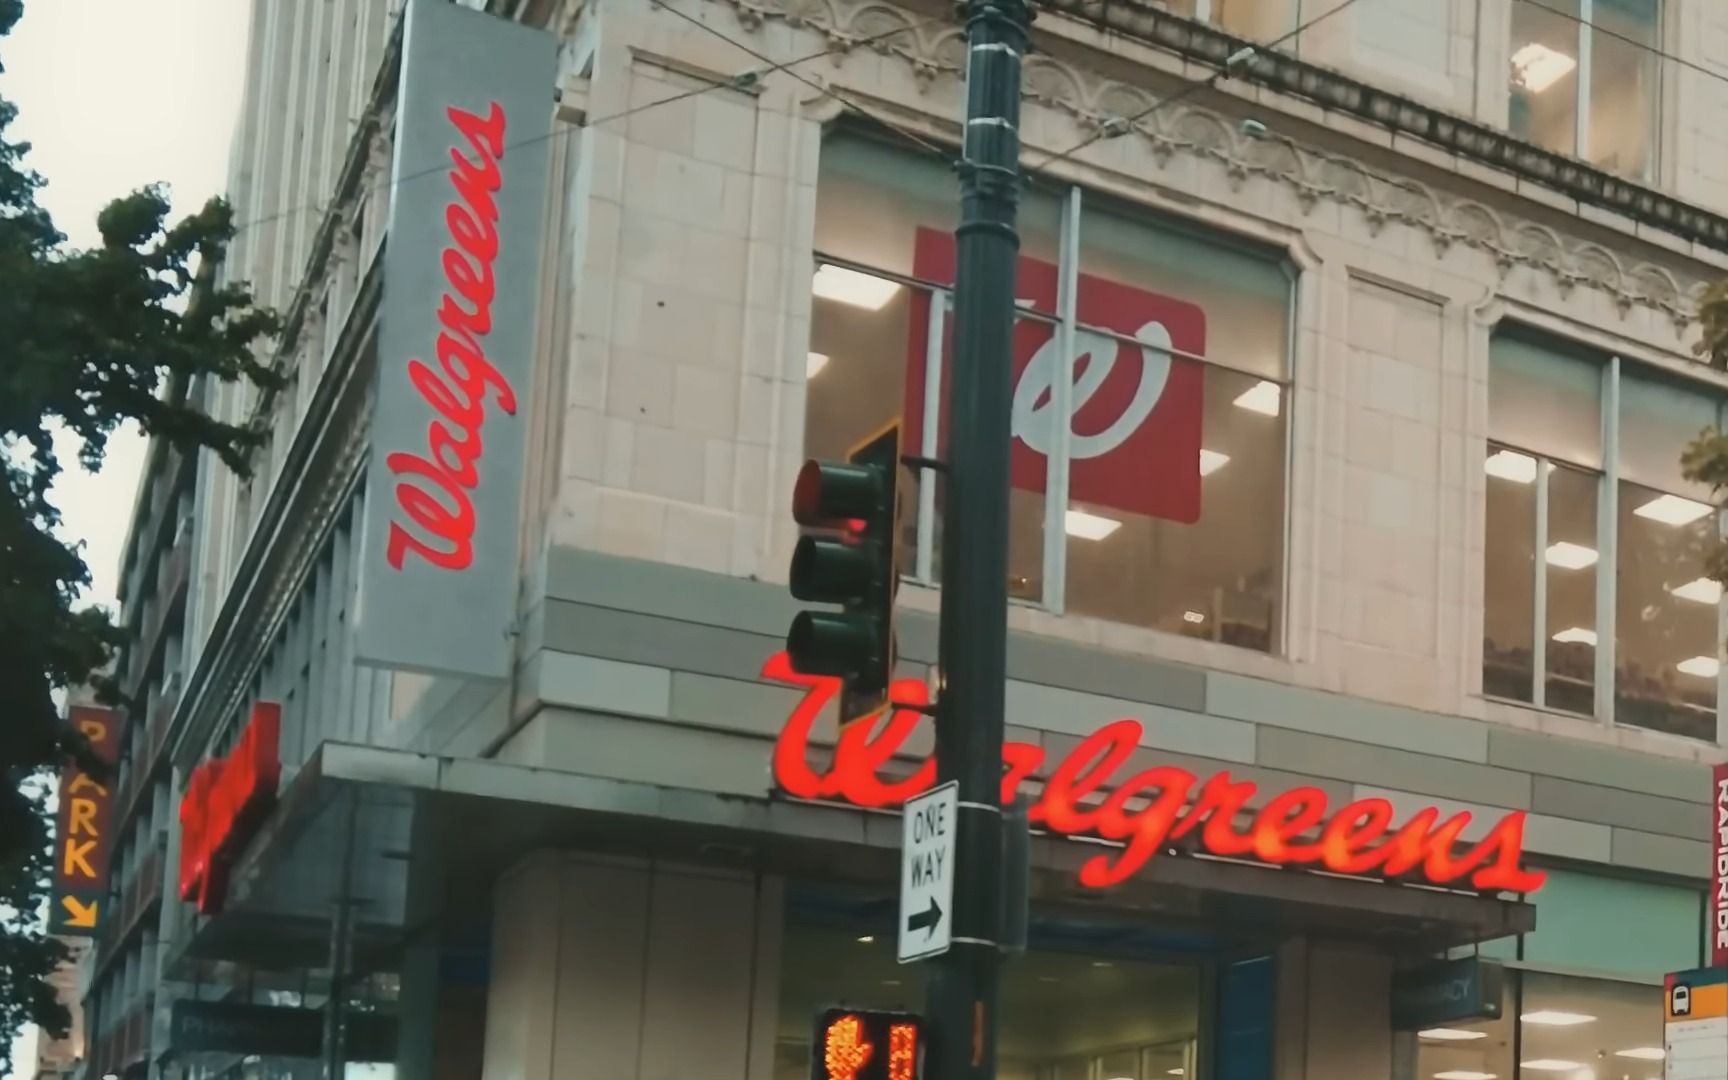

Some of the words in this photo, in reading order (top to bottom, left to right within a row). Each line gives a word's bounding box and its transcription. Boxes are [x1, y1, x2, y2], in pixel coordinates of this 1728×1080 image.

[386, 100, 518, 572] Walgreens
[913, 803, 947, 844] ONE
[911, 846, 946, 888] WAY
